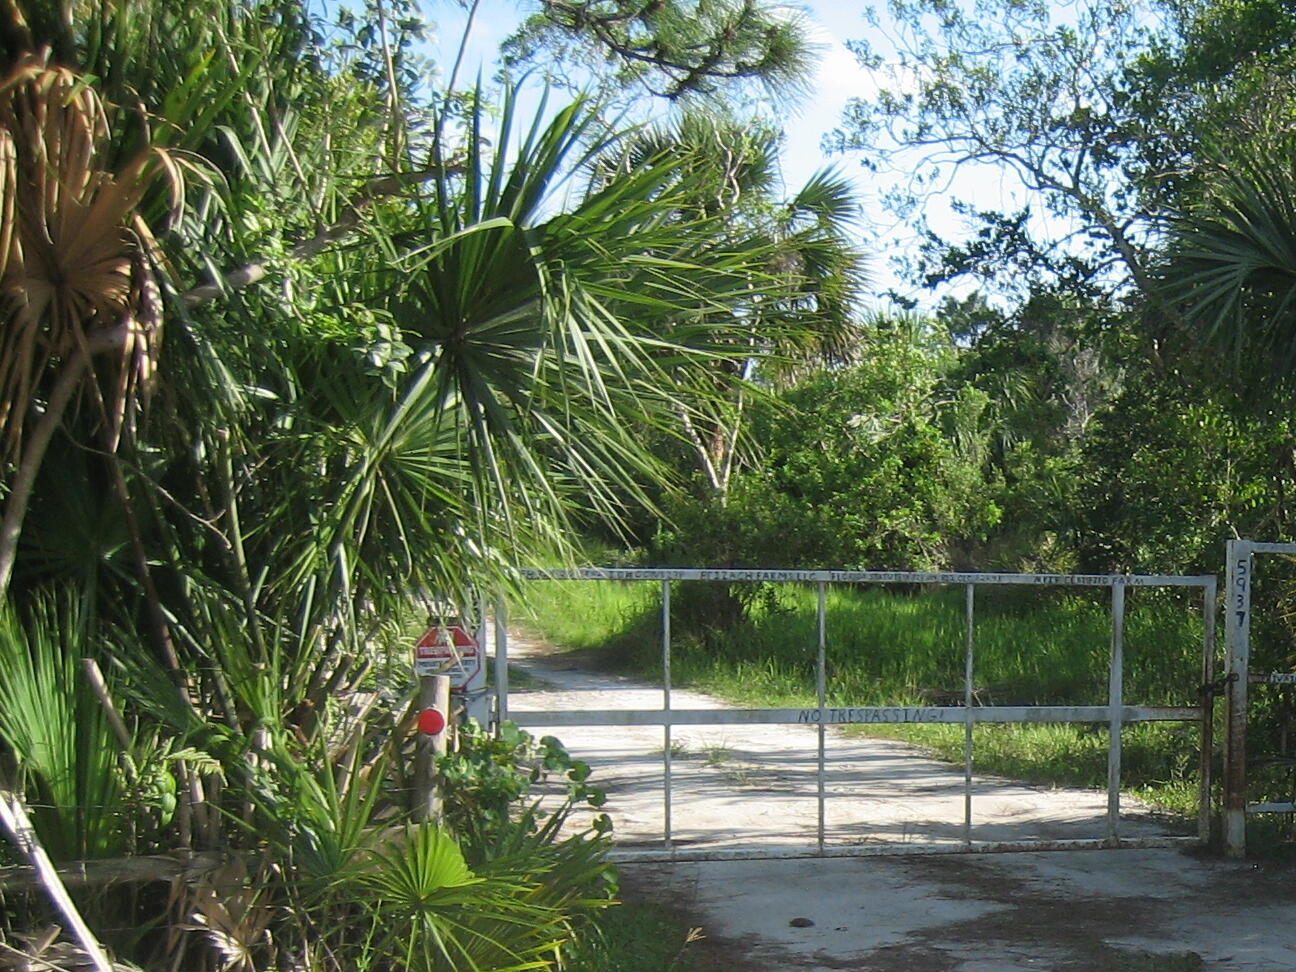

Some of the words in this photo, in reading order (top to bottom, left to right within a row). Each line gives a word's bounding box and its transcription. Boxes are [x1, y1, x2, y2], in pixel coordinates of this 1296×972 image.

[1112, 576, 1144, 585] FARM
[1235, 559, 1247, 627] 5937
[798, 709, 822, 723] NO
